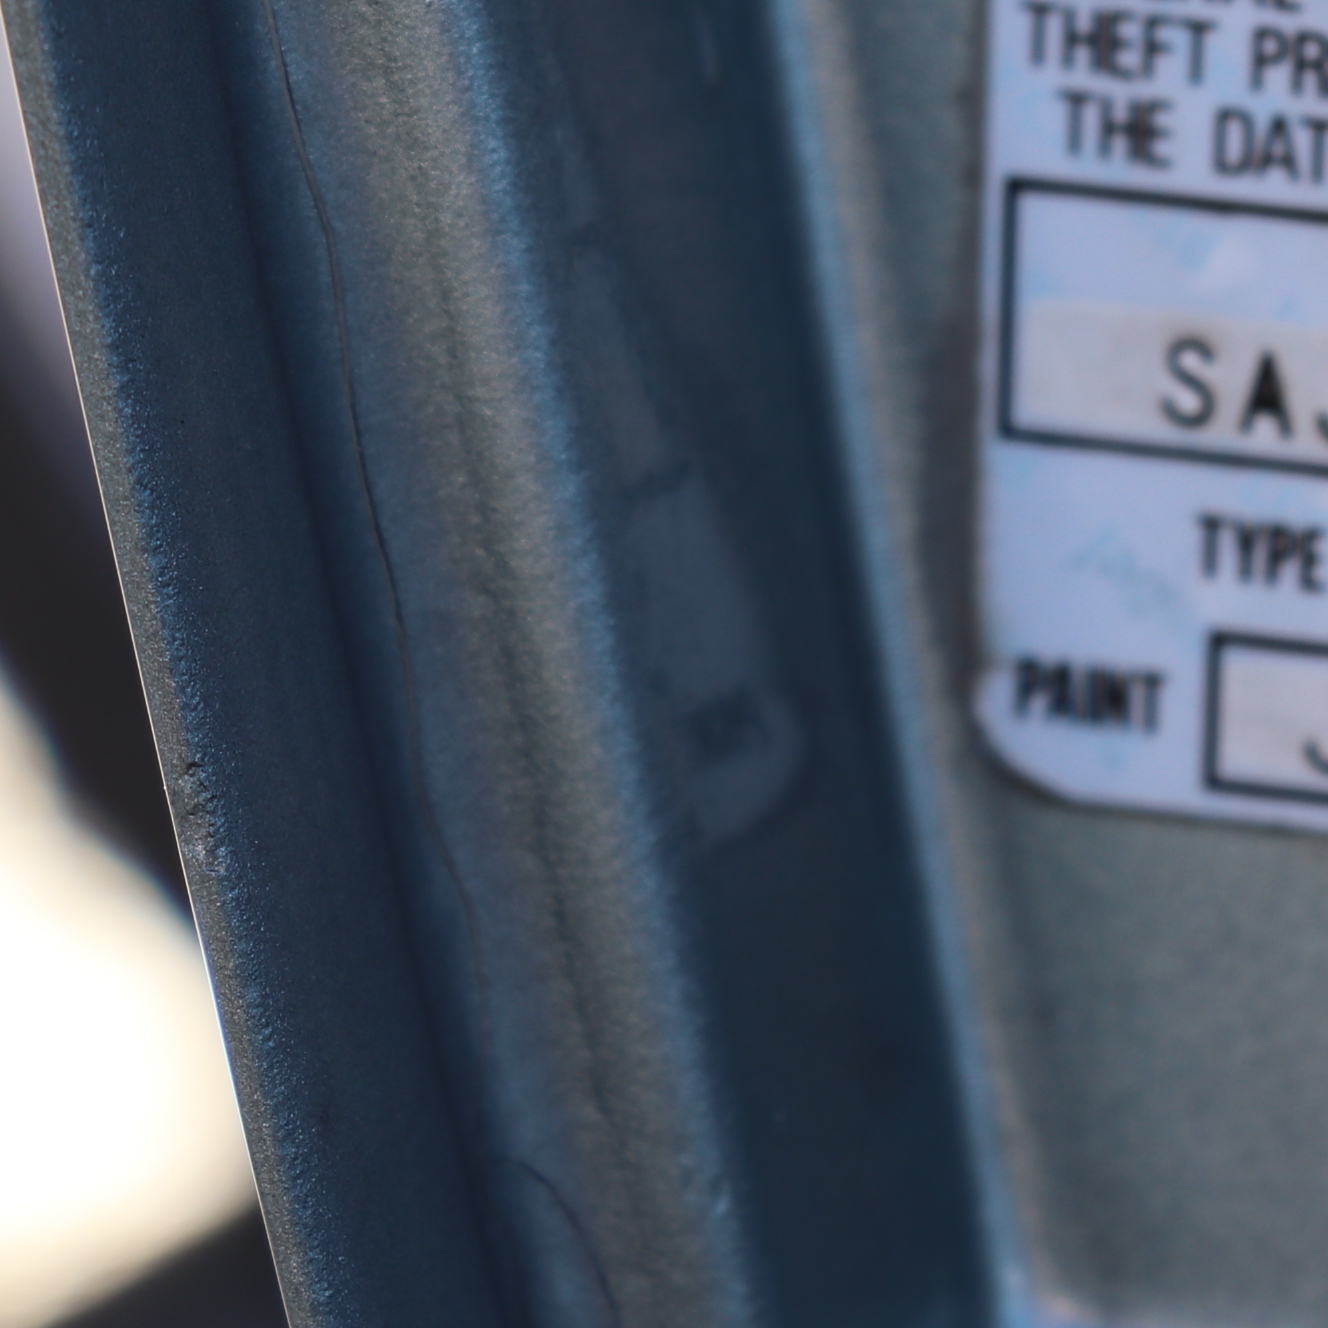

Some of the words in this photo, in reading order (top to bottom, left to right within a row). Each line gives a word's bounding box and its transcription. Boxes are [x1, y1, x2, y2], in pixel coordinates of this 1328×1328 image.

[1019, 0, 1215, 86] THEFT
[1059, 90, 1173, 169] THE
[1196, 513, 1328, 595] TYPE
[1015, 660, 1164, 736] PAINT
